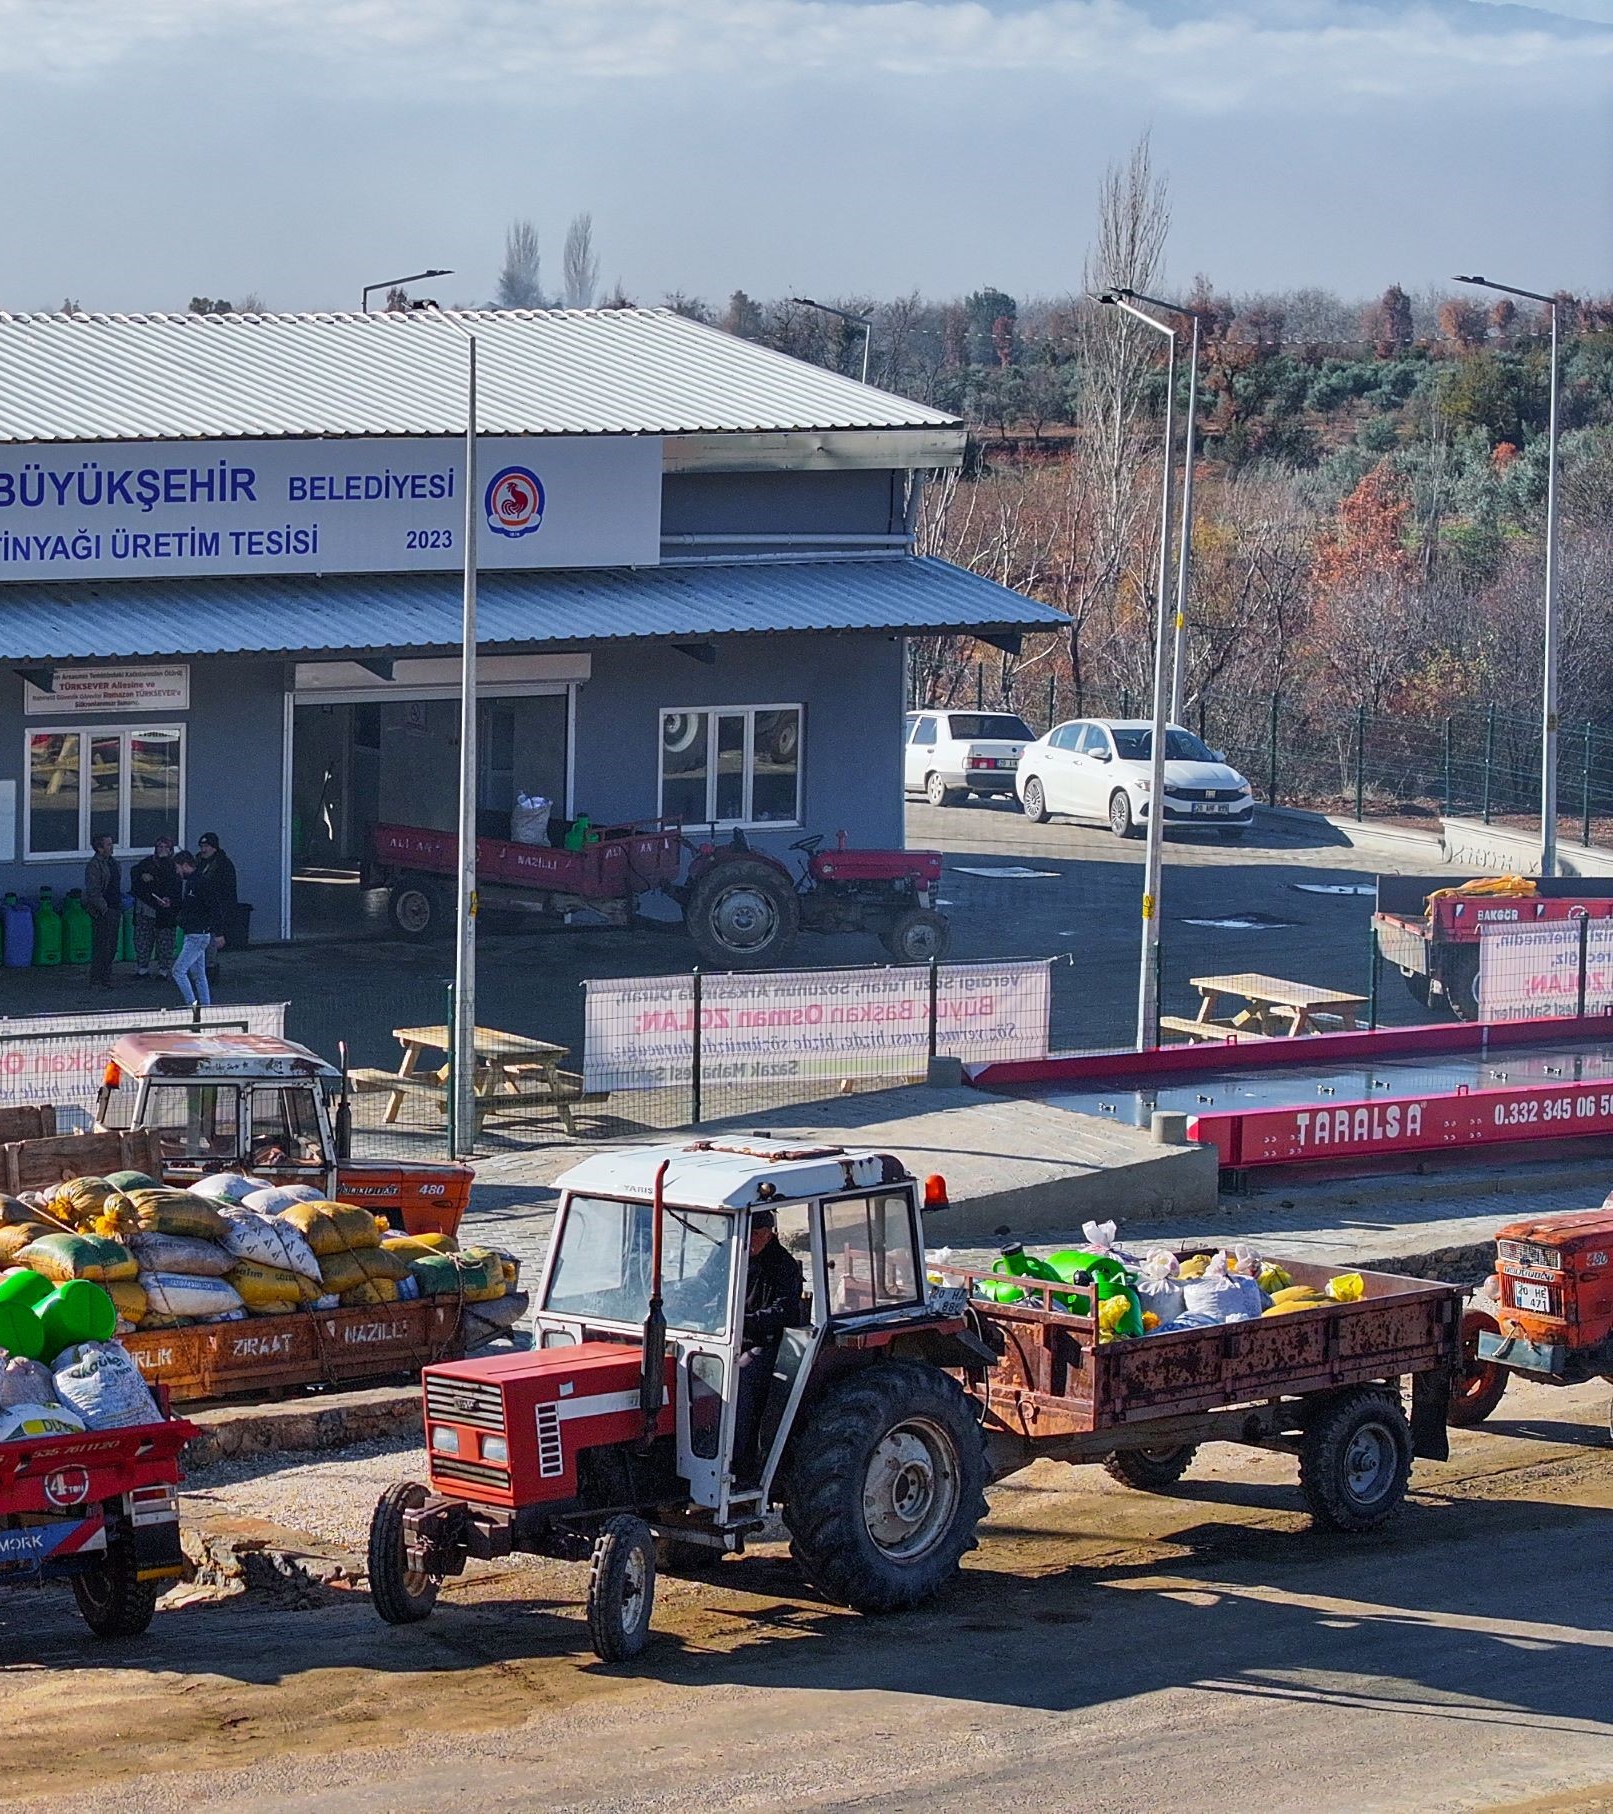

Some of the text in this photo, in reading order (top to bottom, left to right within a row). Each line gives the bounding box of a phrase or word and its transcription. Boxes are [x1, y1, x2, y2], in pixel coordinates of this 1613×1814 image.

[288, 468, 454, 501] BELEDİYESİ
[110, 527, 220, 559] ÜRETİM
[229, 524, 318, 556] TESİSİ
[405, 530, 453, 550] 2023
[59, 681, 109, 691] TÜRKSEVER
[1296, 1102, 1422, 1146] TARALSA
[1494, 1102, 1539, 1127] 0.332
[1542, 1097, 1572, 1121] 345
[1576, 1096, 1596, 1118] 06
[418, 1184, 445, 1196] 480
[1534, 1287, 1548, 1299] HE
[1529, 1299, 1548, 1311] 471
